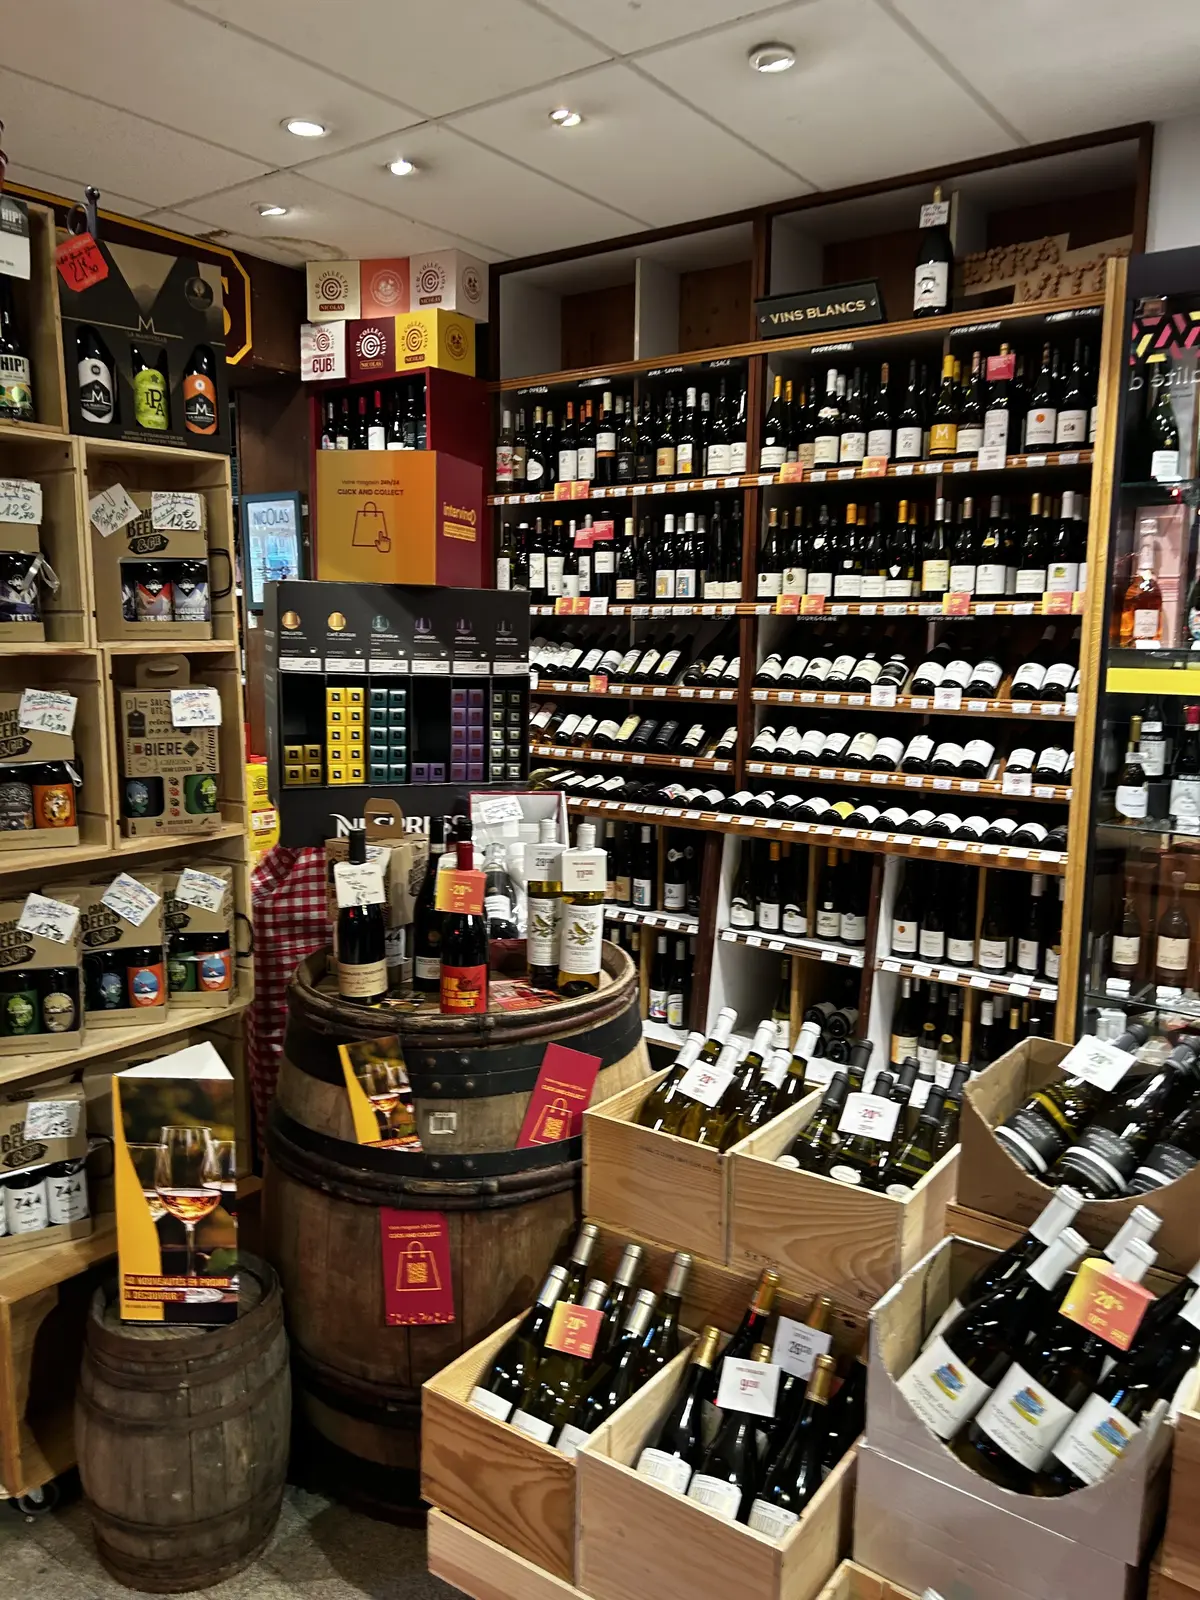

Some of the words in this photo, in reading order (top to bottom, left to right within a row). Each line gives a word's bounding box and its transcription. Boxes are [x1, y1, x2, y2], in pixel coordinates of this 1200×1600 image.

[769, 309, 804, 325] VINS
[806, 299, 866, 319] BLANCS
[312, 357, 335, 373] CUB!
[936, 426, 949, 440] M
[253, 508, 290, 526] NICOLAS
[10, 614, 32, 622] YETI
[145, 742, 183, 756] BIERE
[206, 728, 217, 772] delicious
